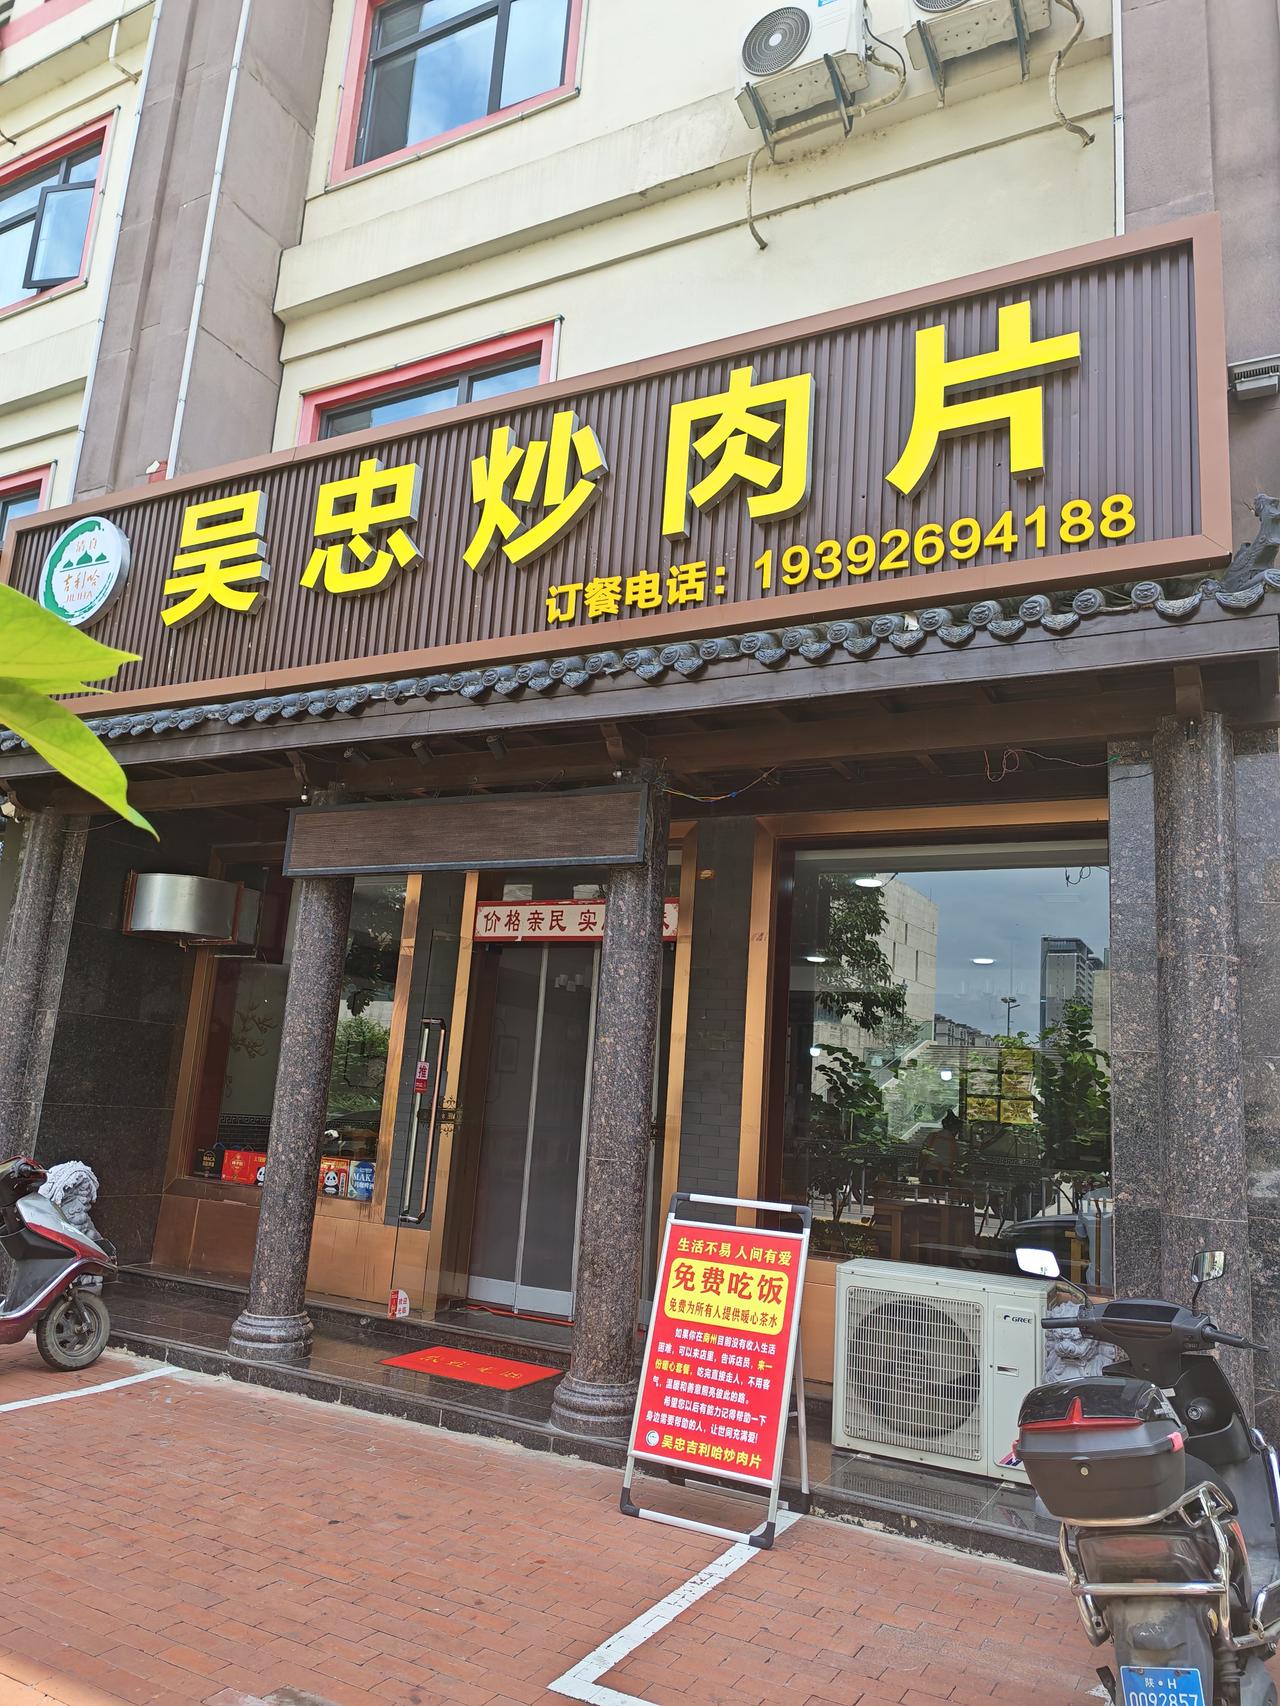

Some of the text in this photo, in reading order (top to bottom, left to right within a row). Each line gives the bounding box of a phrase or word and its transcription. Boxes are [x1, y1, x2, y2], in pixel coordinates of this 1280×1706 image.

[161, 300, 1082, 629] 吴忠炒肉片
[754, 494, 1136, 589] 19392694188
[483, 909, 567, 933] 价格亲民
[677, 1237, 793, 1267] 生活不易 人间有爱
[672, 1262, 784, 1306] 免费吃饭
[668, 1297, 779, 1329] 免费为所有人提供暖心茶水
[663, 1395, 768, 1428] 希望您以后有能力记得帮助一下
[660, 1434, 763, 1470] 吴忠吉利哈炒肉片
[1128, 1691, 1199, 1706] 0092857
